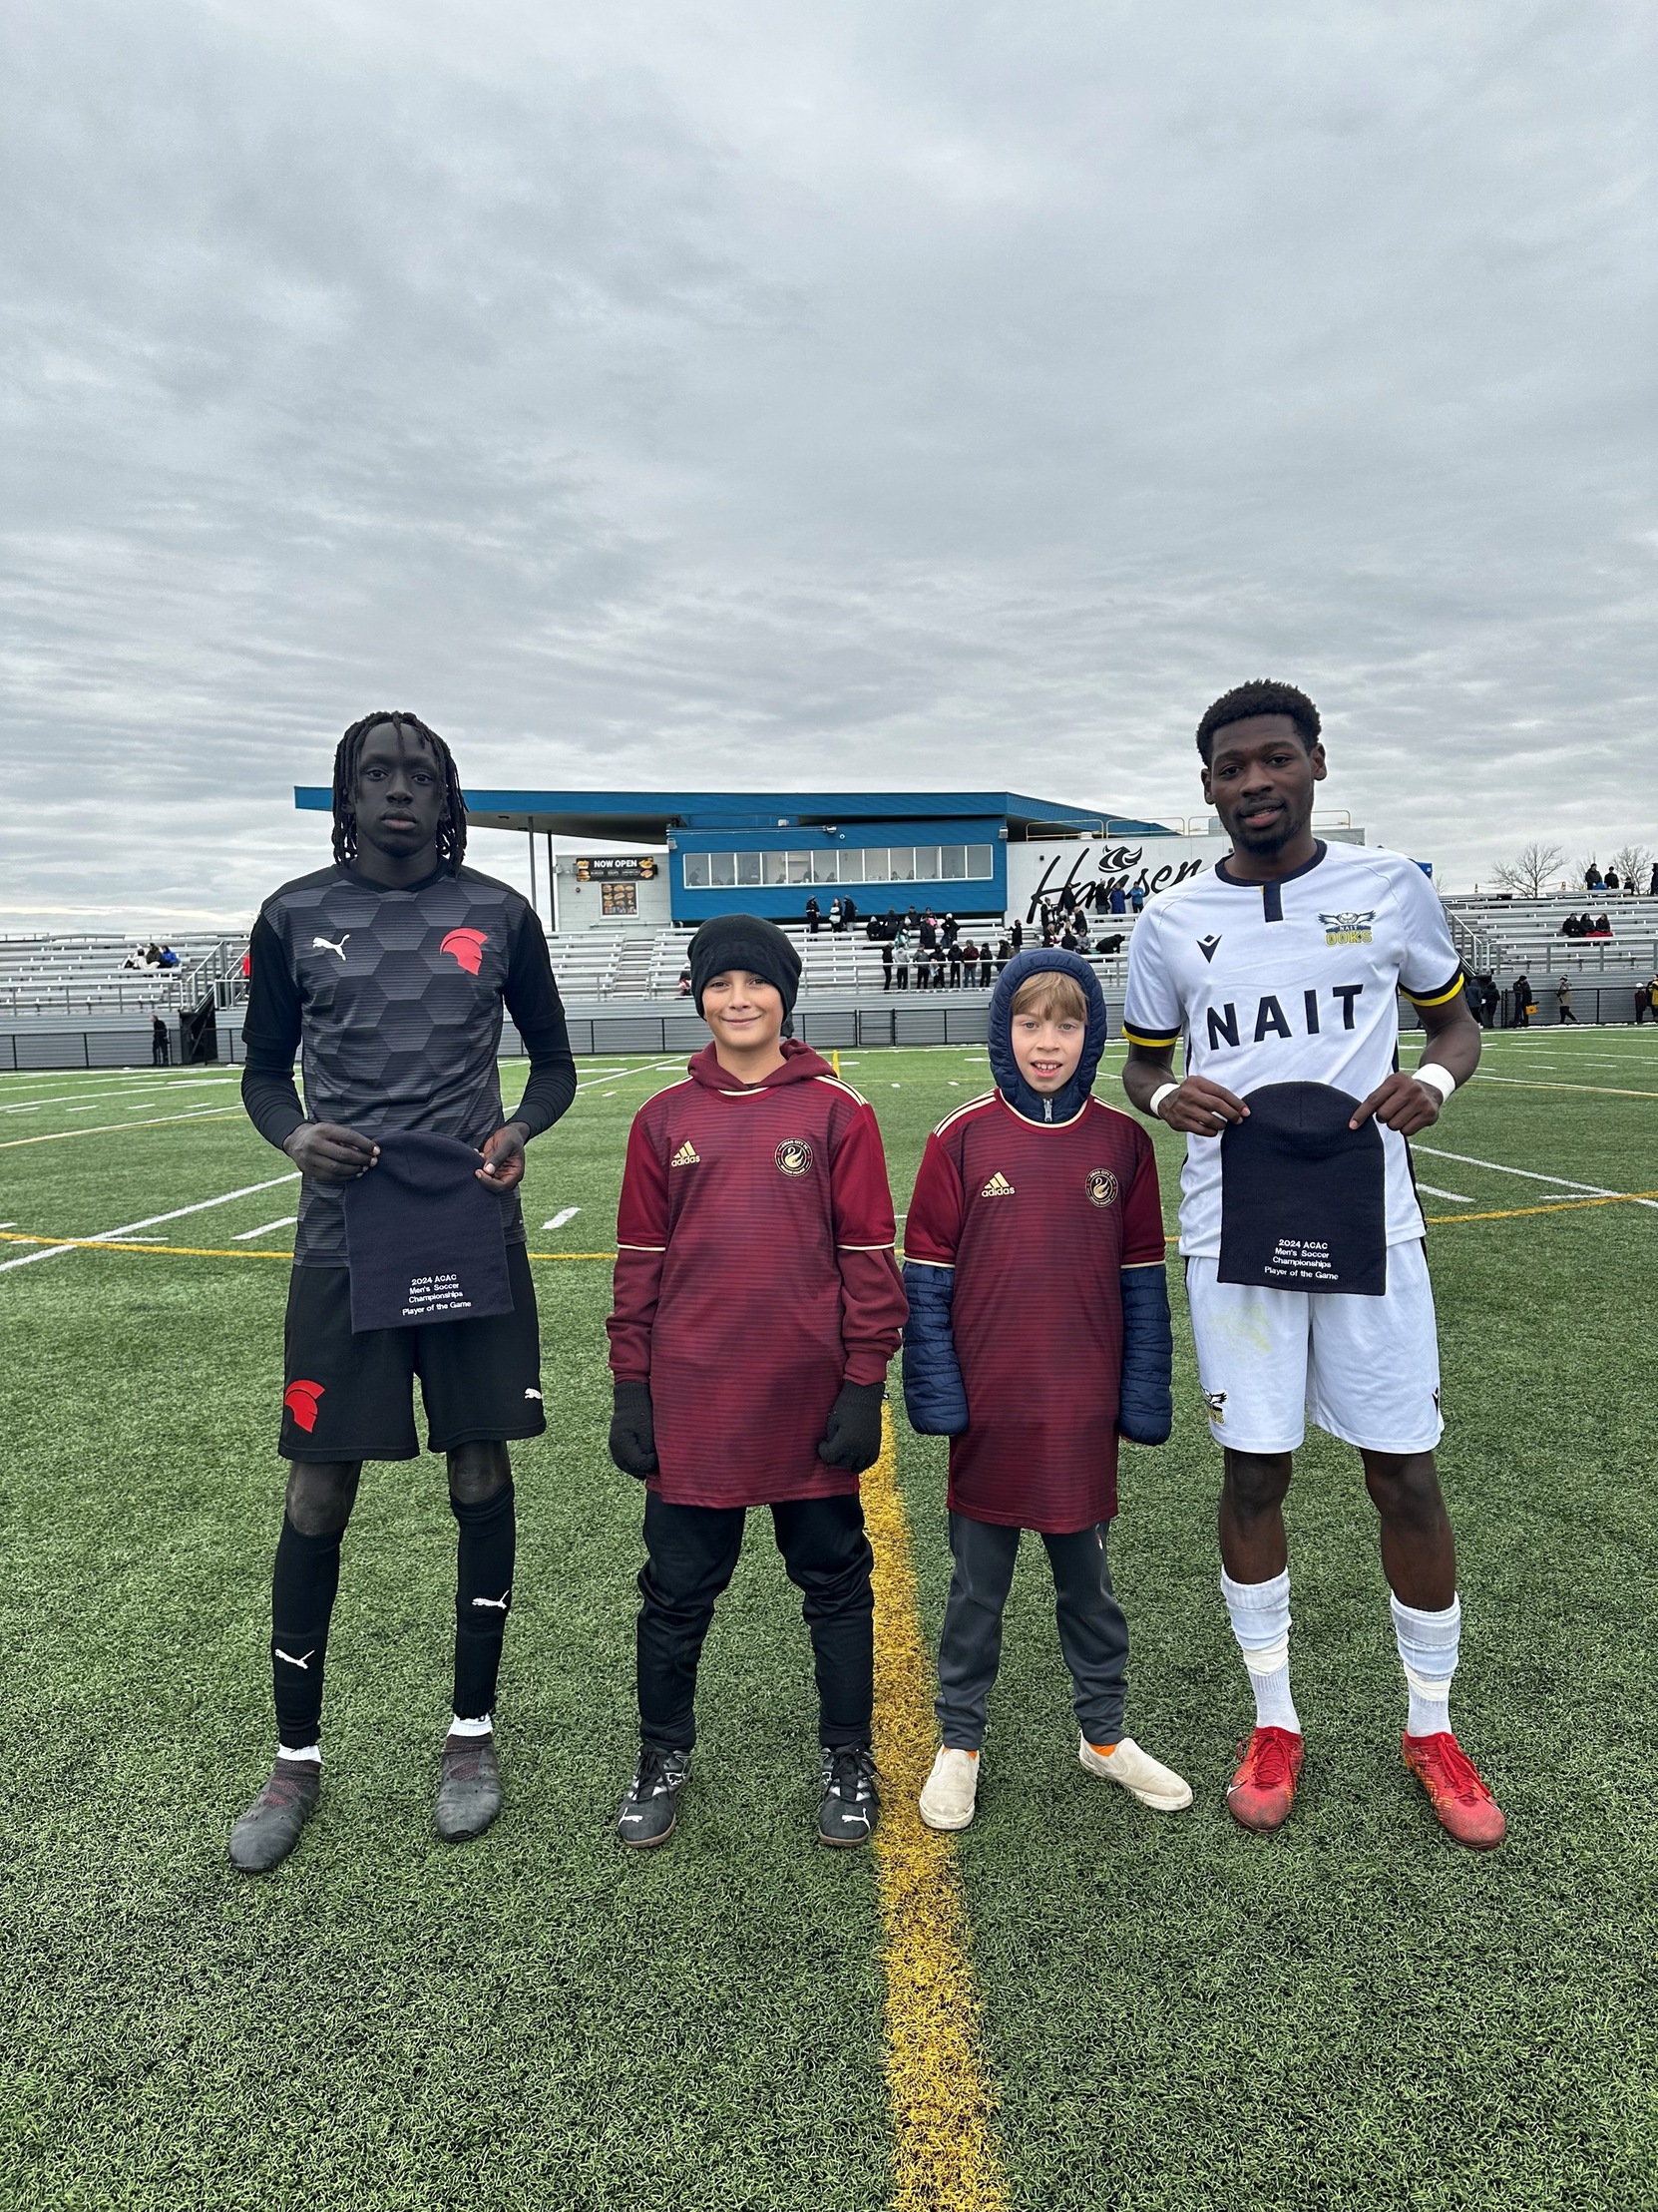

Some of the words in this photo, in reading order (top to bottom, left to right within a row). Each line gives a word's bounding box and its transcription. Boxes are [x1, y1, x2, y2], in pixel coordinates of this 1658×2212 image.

[1027, 847, 1210, 924] Hansen
[1325, 930, 1373, 946] OOKS
[1207, 984, 1364, 1051] NAIT
[671, 1154, 701, 1167] adidas
[981, 1186, 1016, 1197] adidas
[1278, 1239, 1301, 1248] 2024
[1303, 1241, 1328, 1250] ACAC
[1275, 1247, 1298, 1256] Men's
[1301, 1249, 1330, 1259] Soccer
[1272, 1255, 1332, 1269] Championships
[1264, 1265, 1287, 1276] Player
[1315, 1271, 1339, 1280] Game
[411, 1276, 433, 1285] 2024
[434, 1274, 457, 1283] ACAC
[409, 1285, 431, 1295] Men's
[433, 1282, 460, 1291] Soccer
[402, 1306, 425, 1316] Player
[449, 1300, 472, 1309] Game
